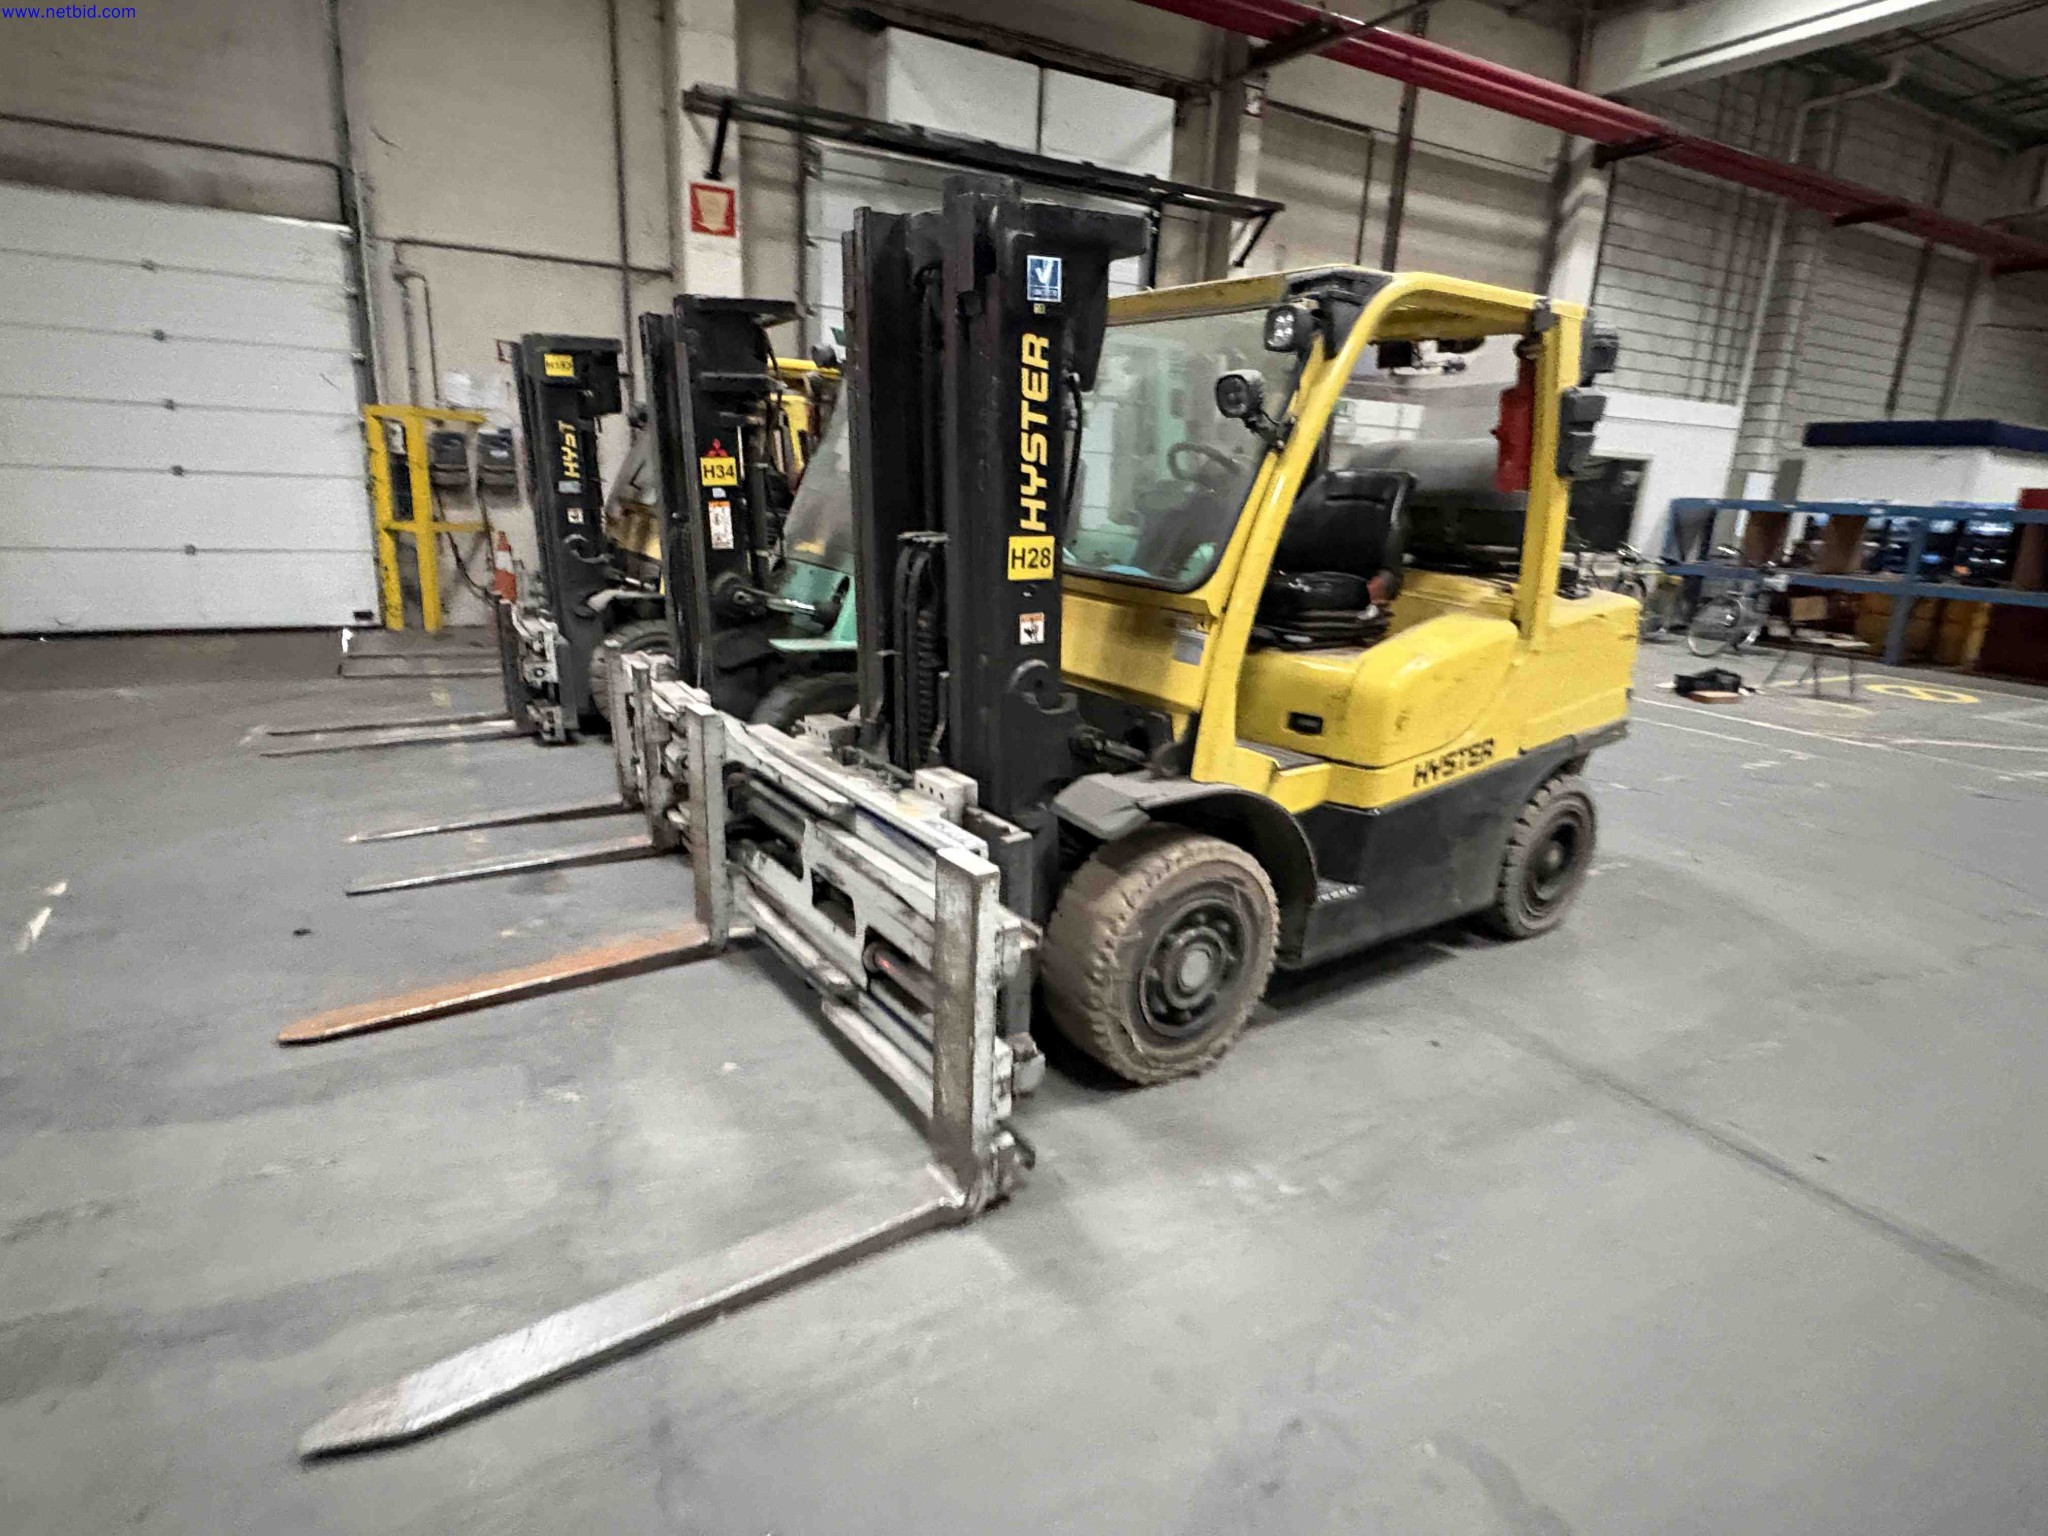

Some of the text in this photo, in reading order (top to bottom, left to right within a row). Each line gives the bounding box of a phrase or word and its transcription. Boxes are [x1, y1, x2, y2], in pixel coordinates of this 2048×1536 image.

[1020, 333, 1049, 531] HYSTER
[703, 464, 735, 479] H34
[1011, 547, 1051, 568] H28
[1413, 737, 1494, 787] HYSTER
